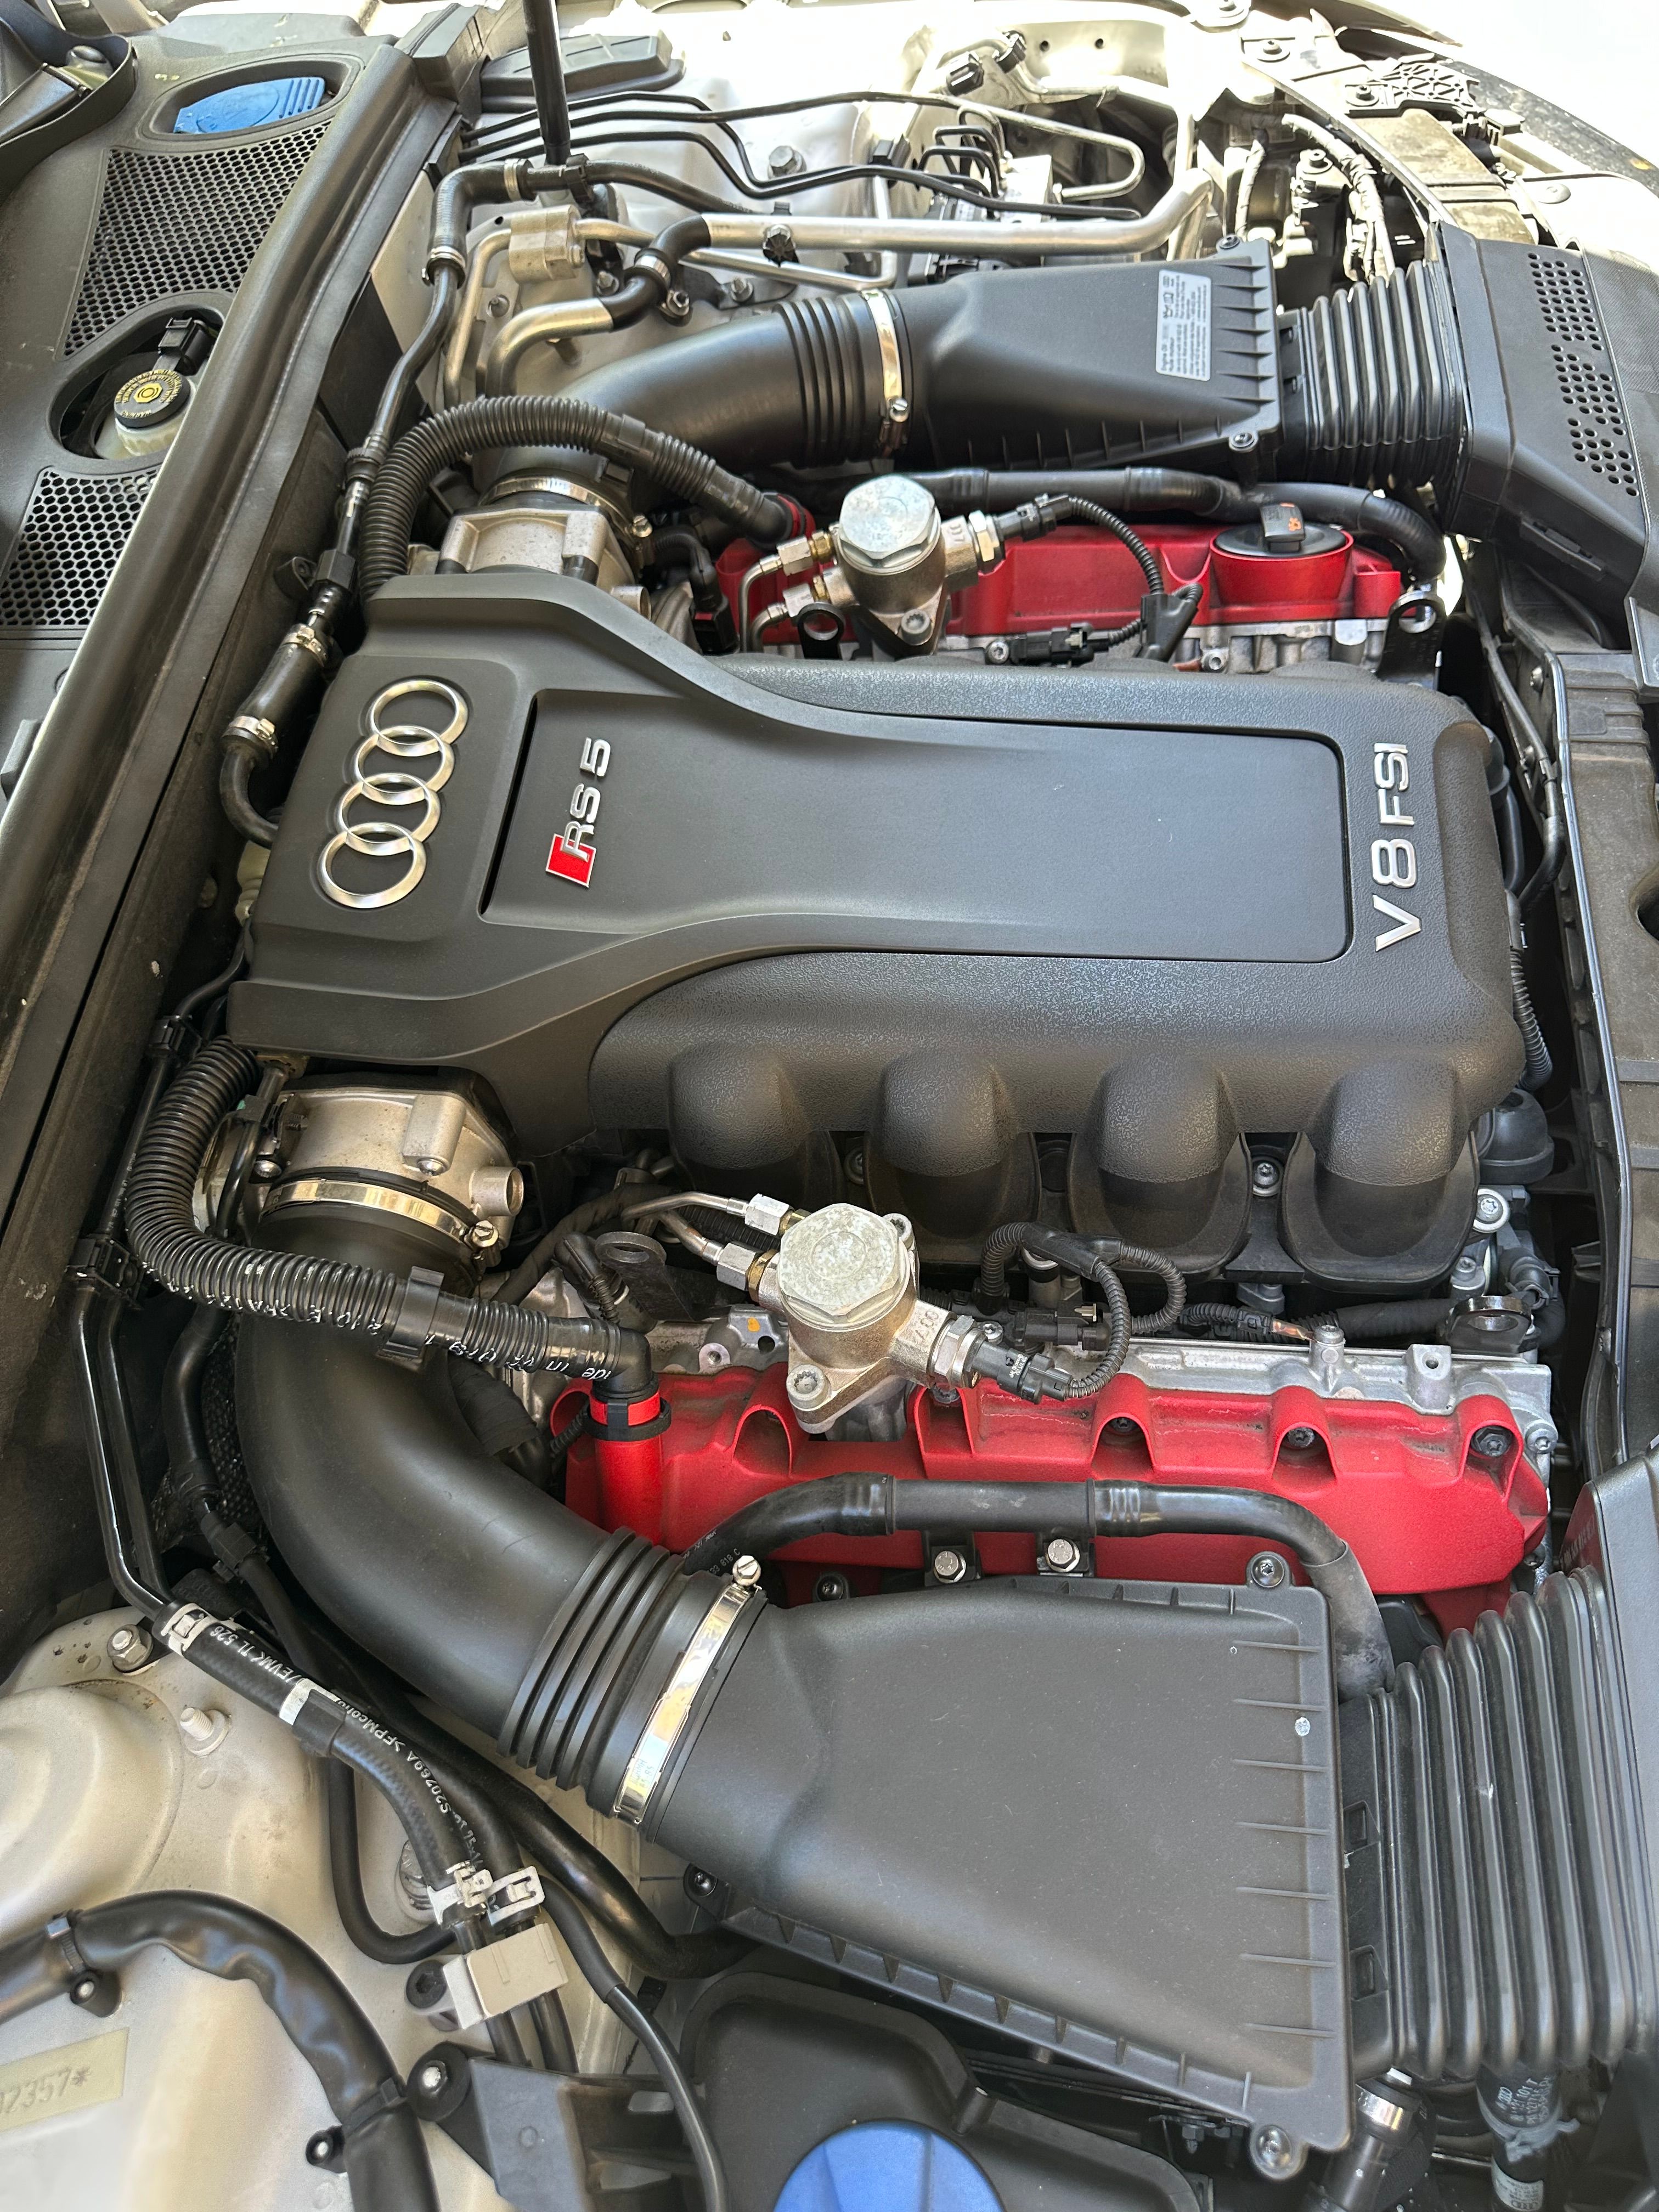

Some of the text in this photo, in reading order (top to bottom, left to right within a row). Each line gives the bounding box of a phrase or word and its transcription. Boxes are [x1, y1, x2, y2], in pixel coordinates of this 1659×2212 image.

[561, 736, 611, 862] RS 5
[1371, 742, 1422, 953] V8 FSI
[720, 1554, 733, 1566] 818
[210, 1626, 238, 1646] 526
[238, 1640, 254, 1657] TL
